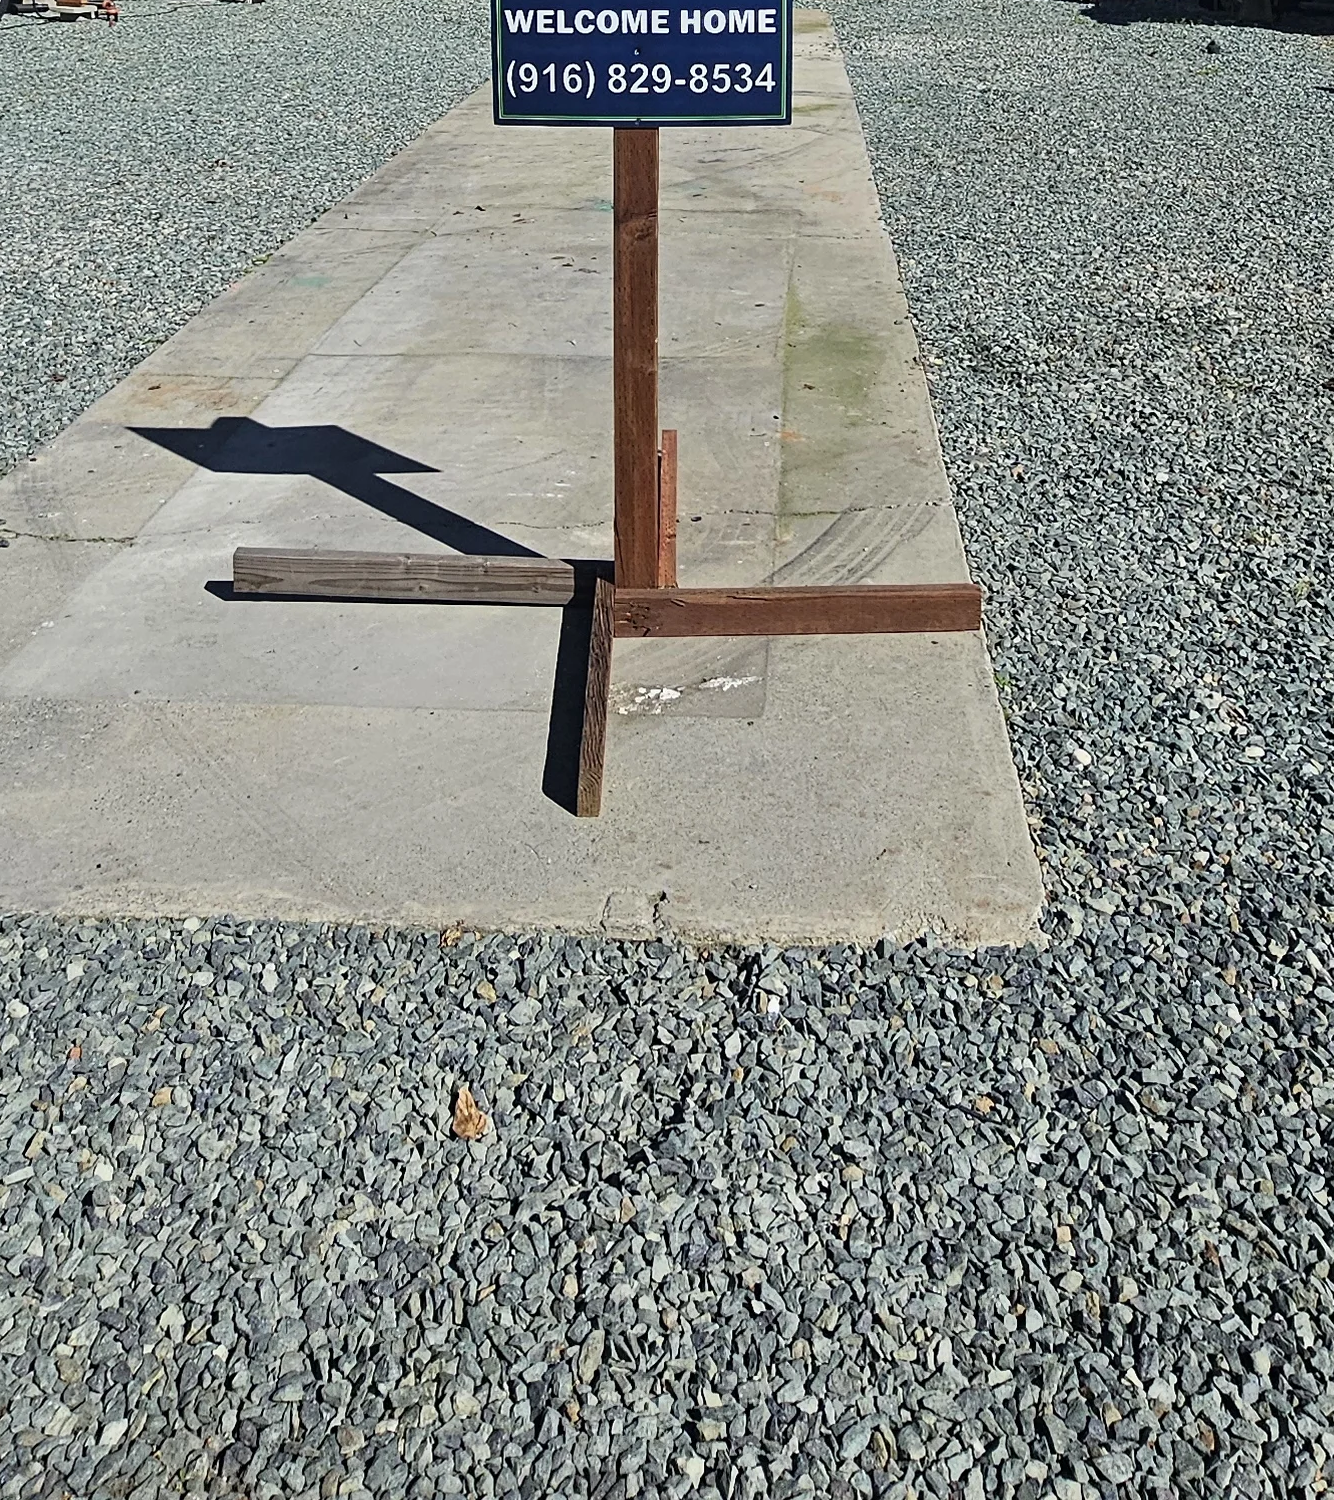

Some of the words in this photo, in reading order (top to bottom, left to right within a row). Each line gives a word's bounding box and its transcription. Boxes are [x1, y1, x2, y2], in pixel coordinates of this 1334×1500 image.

[504, 8, 670, 34] WELCOME
[679, 8, 777, 34] HOME
[506, 59, 596, 99] (916)
[607, 62, 777, 94] 829-8534
